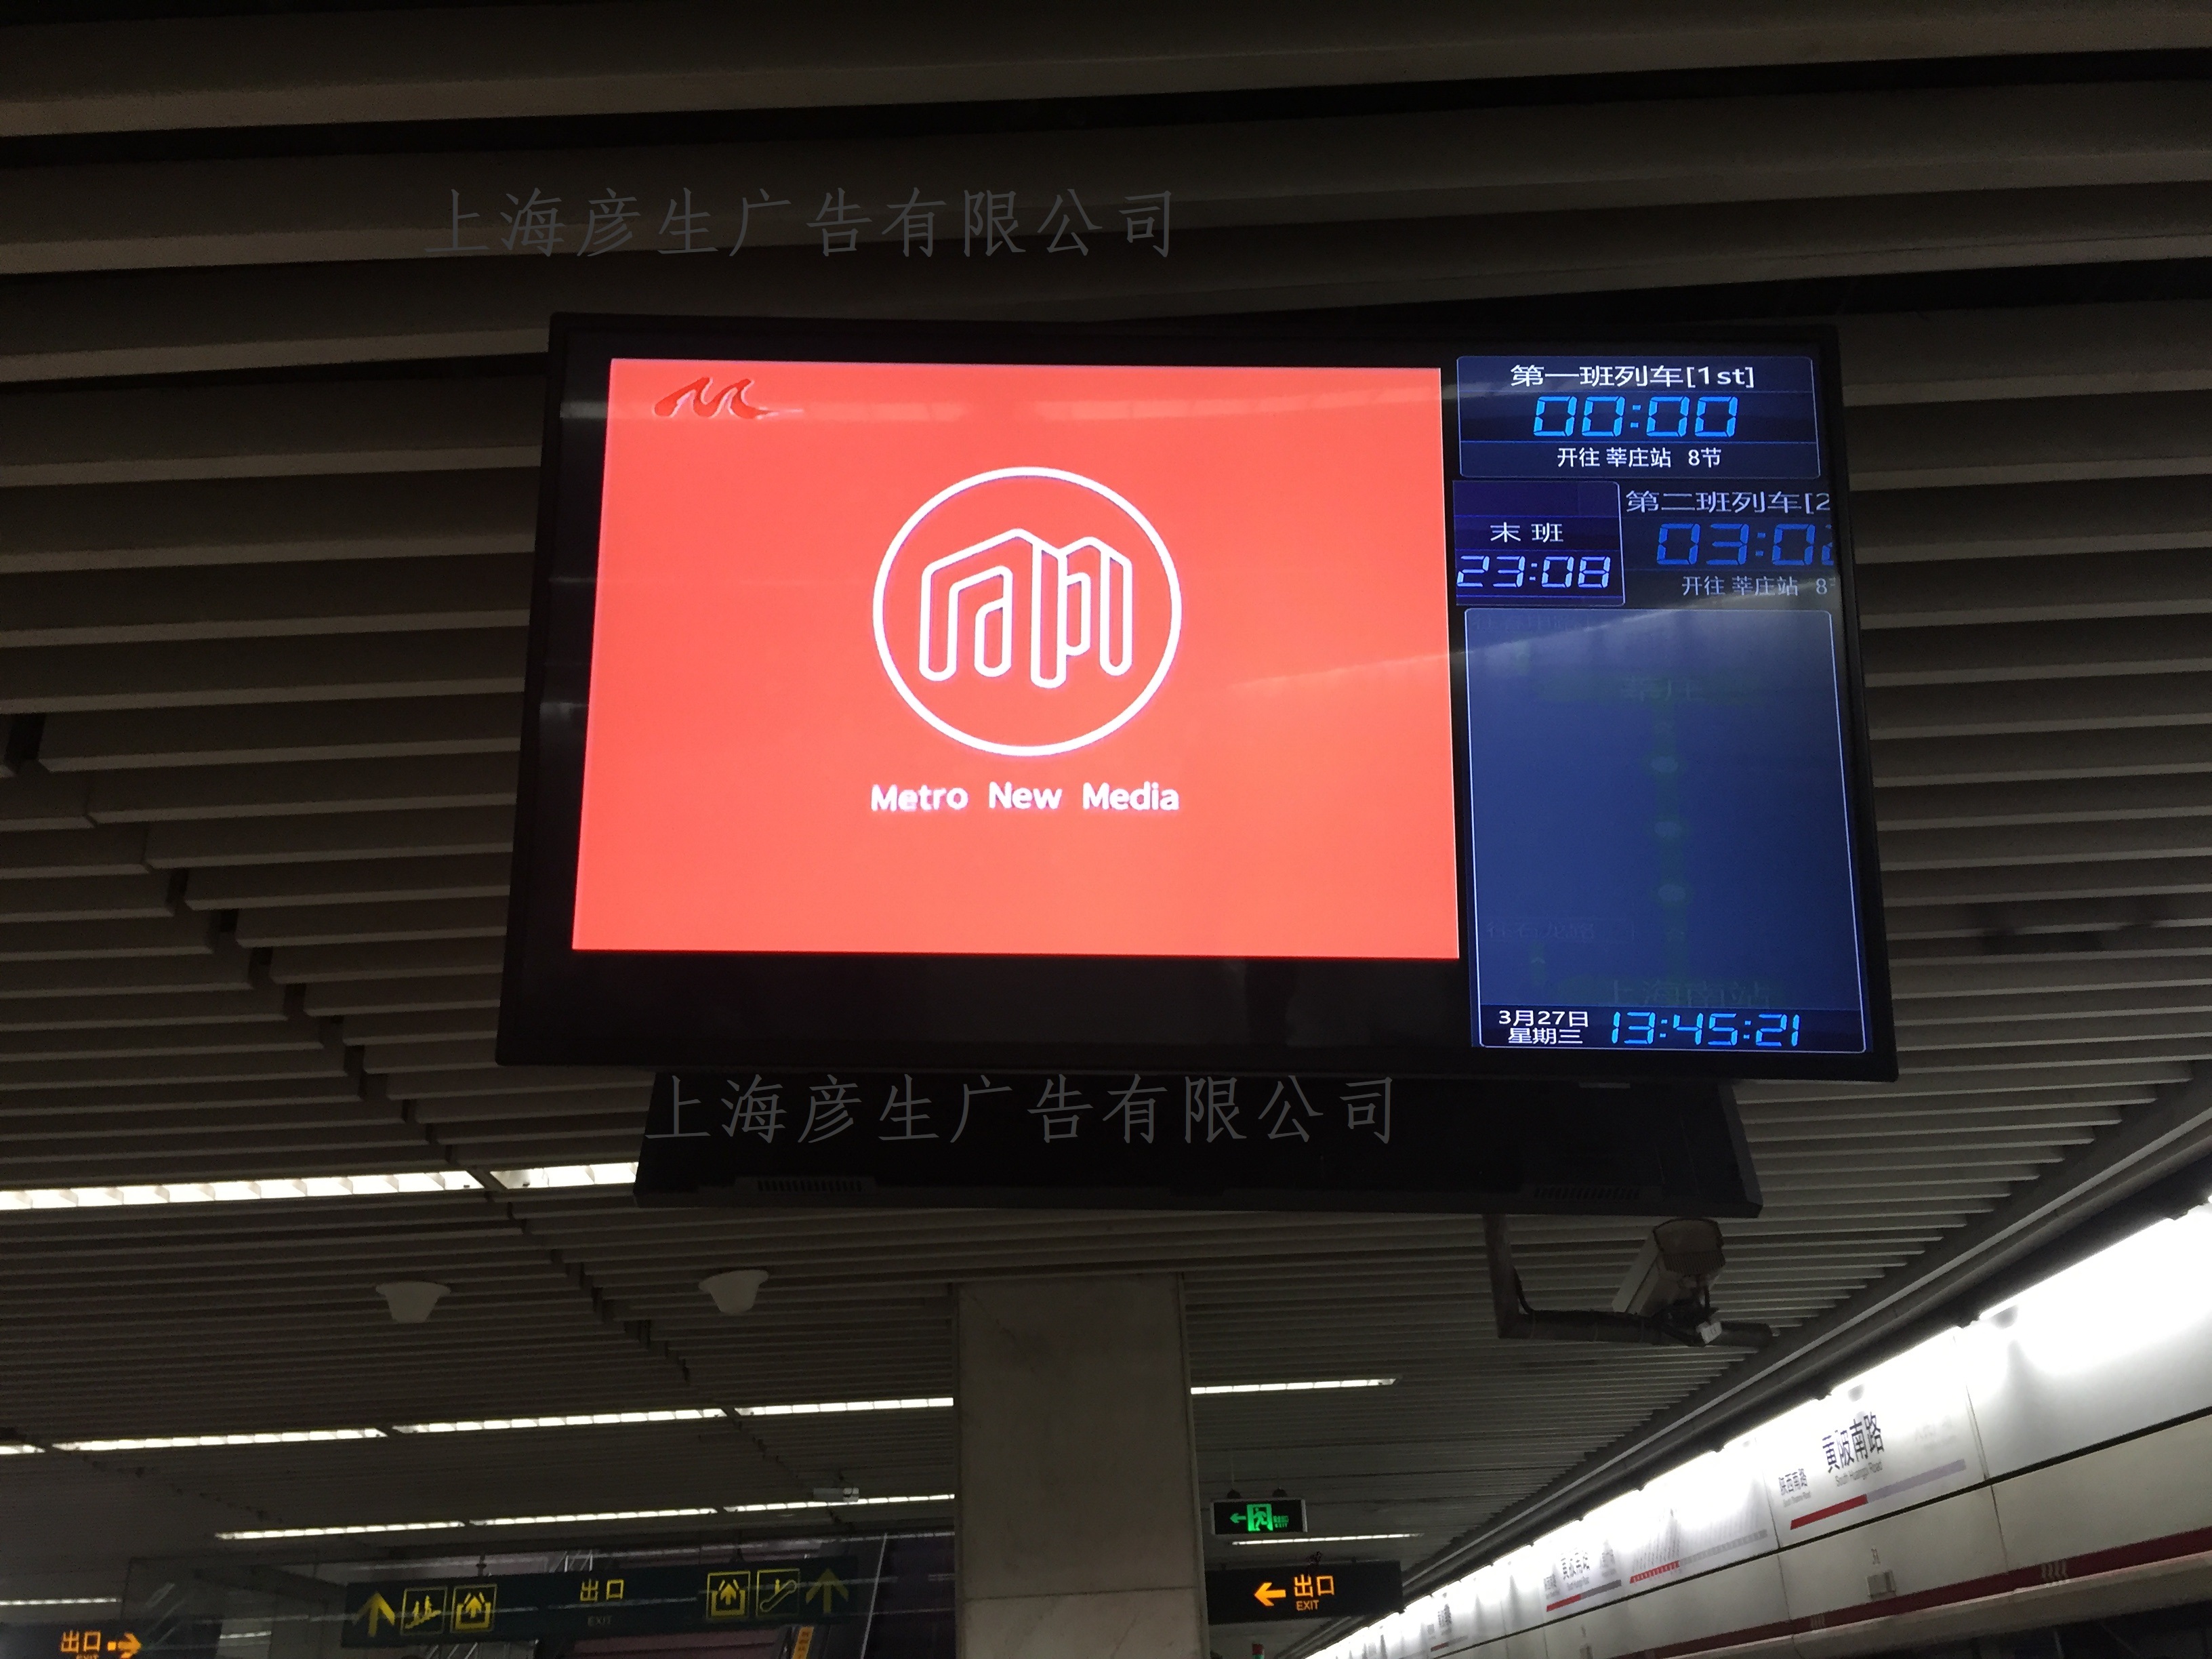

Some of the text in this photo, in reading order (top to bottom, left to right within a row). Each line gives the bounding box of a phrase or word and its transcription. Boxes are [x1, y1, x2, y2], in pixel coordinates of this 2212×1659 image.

[1534, 396, 1738, 438] 00:00
[1557, 447, 1722, 468] 开往 莘庄站 8节
[1456, 555, 1611, 588] 23:08
[1681, 575, 1725, 596] 开往
[1732, 575, 1799, 596] 莘庄站
[871, 781, 1180, 812] Metro New Media
[1498, 1009, 1589, 1027] 3月27日
[1508, 1027, 1584, 1045] 星期三
[1611, 1012, 1800, 1047] 13:45:21
[579, 1578, 624, 1601] 出口
[1294, 1574, 1334, 1597] 出口
[1296, 1600, 1319, 1612] EXIT
[61, 1630, 101, 1652] 出口
